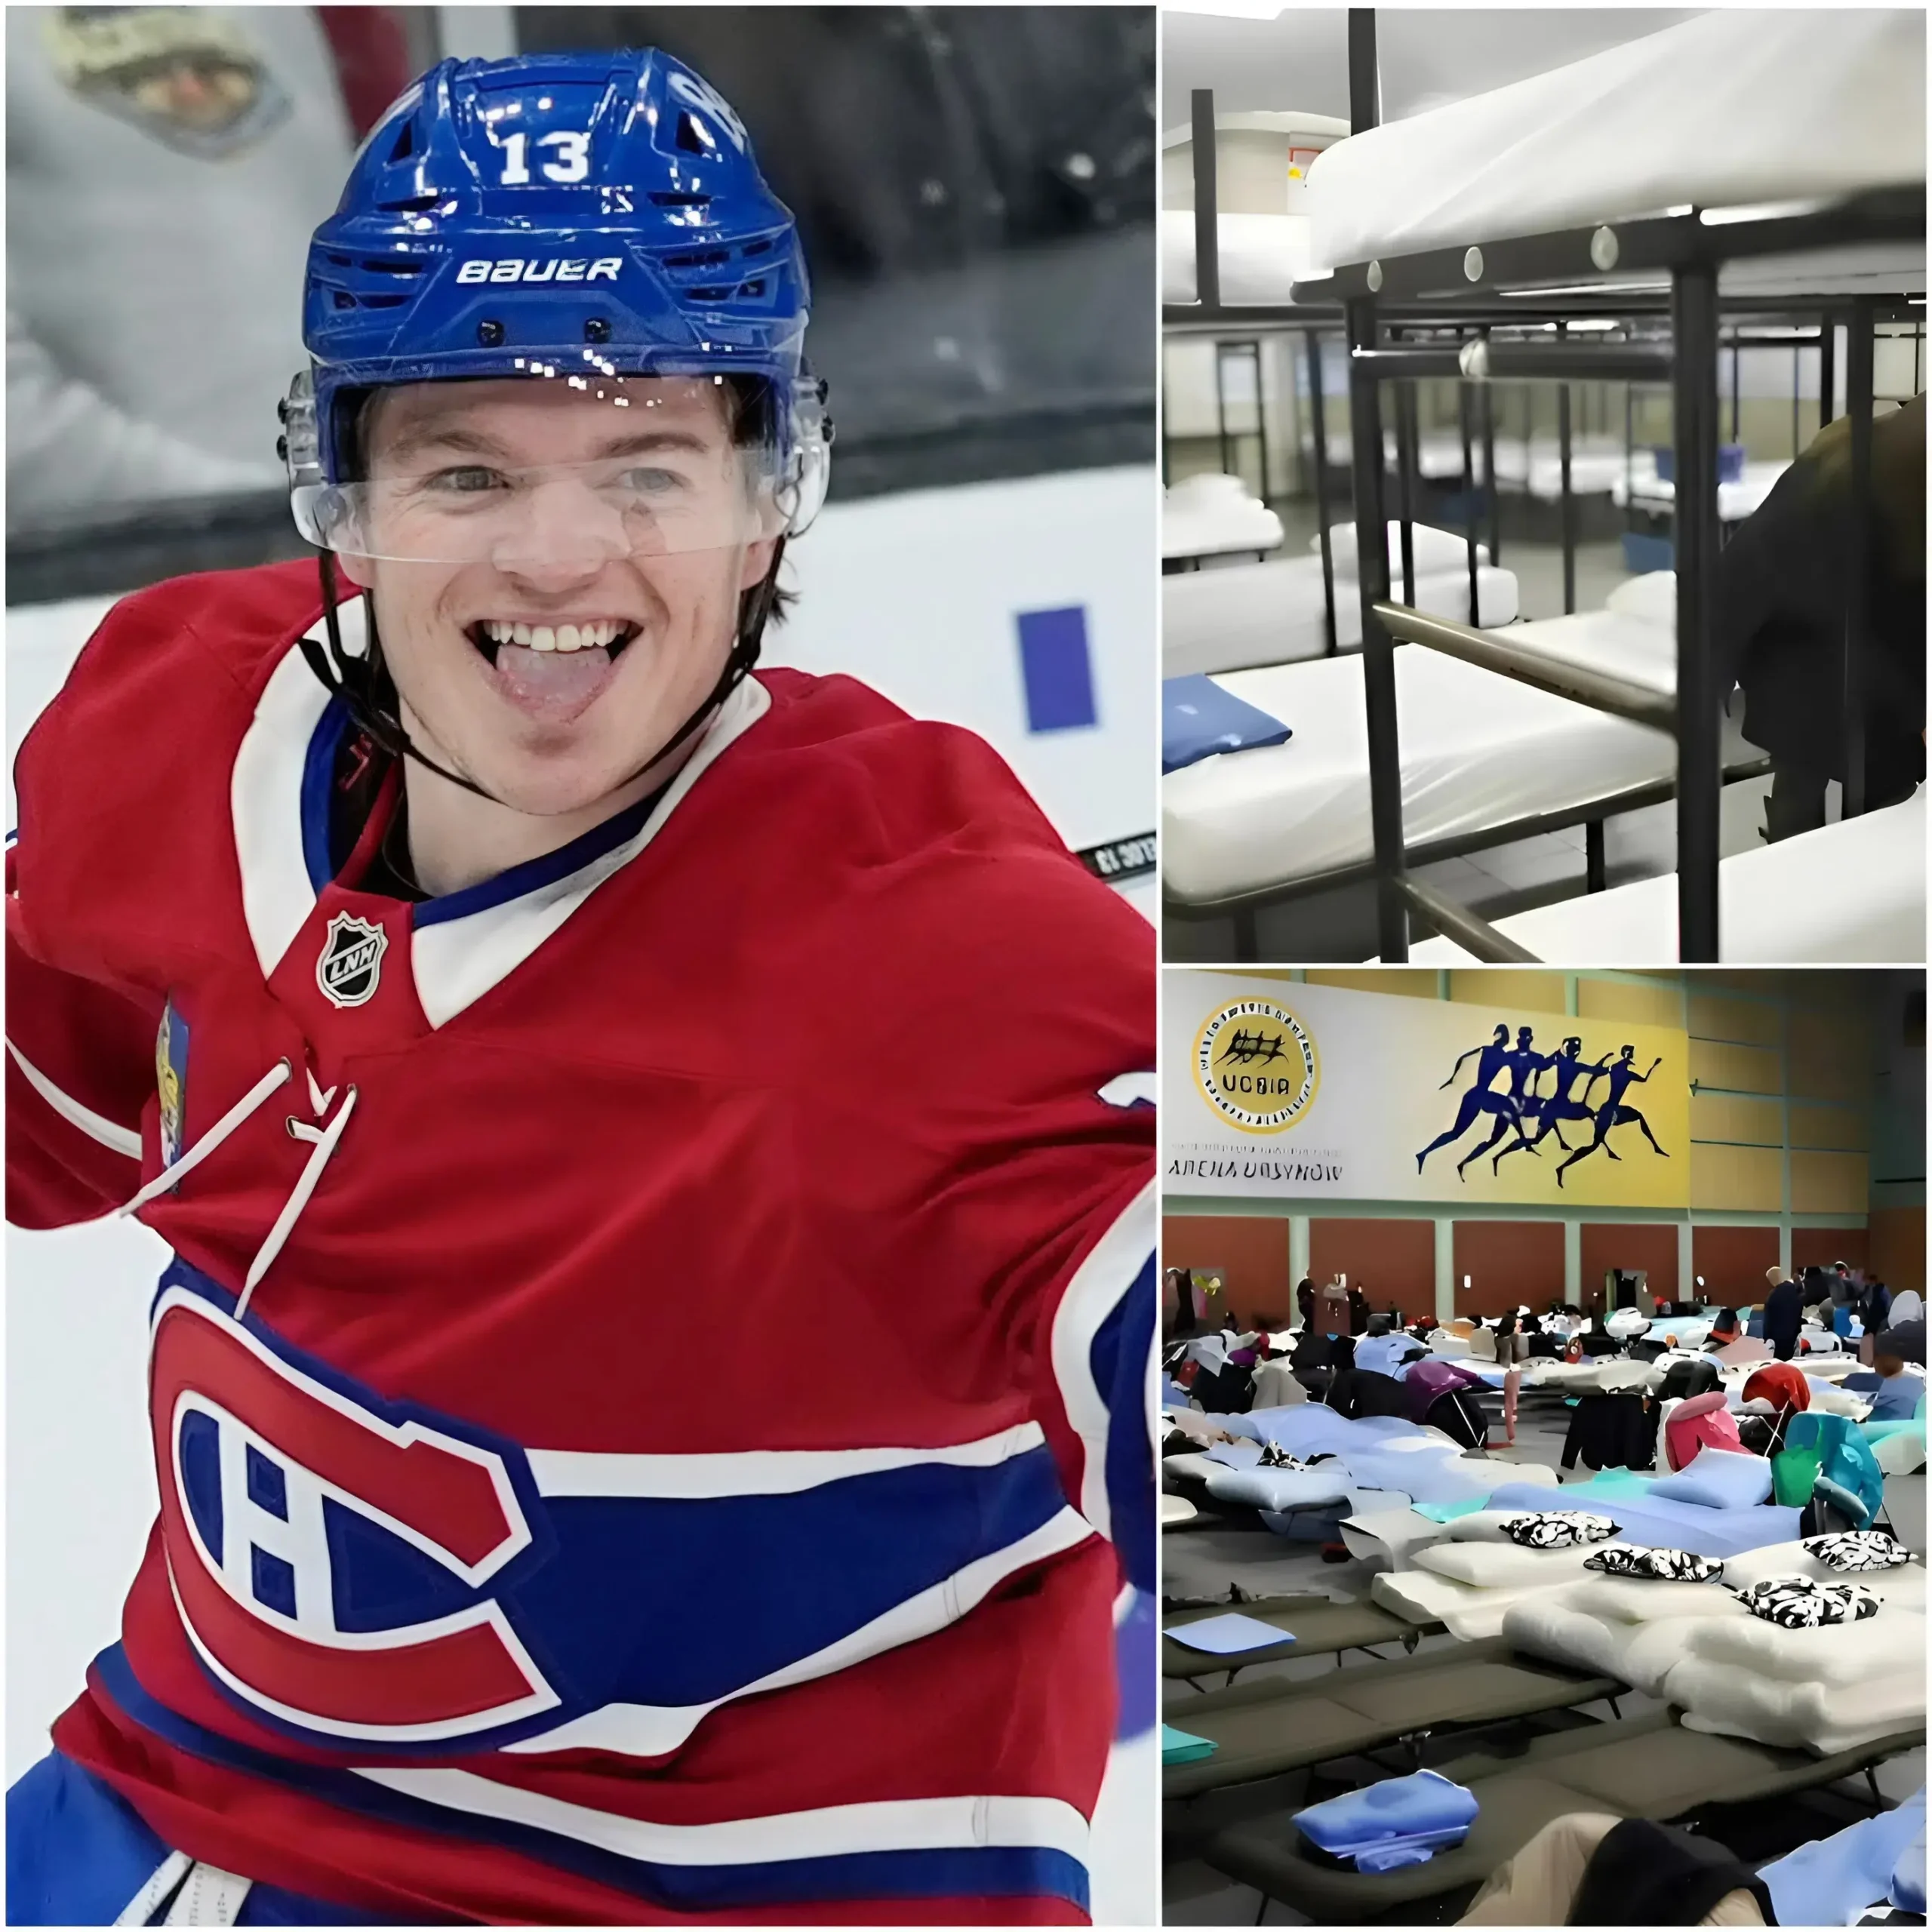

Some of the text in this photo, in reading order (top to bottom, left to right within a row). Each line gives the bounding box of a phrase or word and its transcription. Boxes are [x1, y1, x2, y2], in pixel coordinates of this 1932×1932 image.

[500, 131, 590, 184] 13
[456, 257, 623, 283] BAUER
[330, 941, 376, 982] LNH
